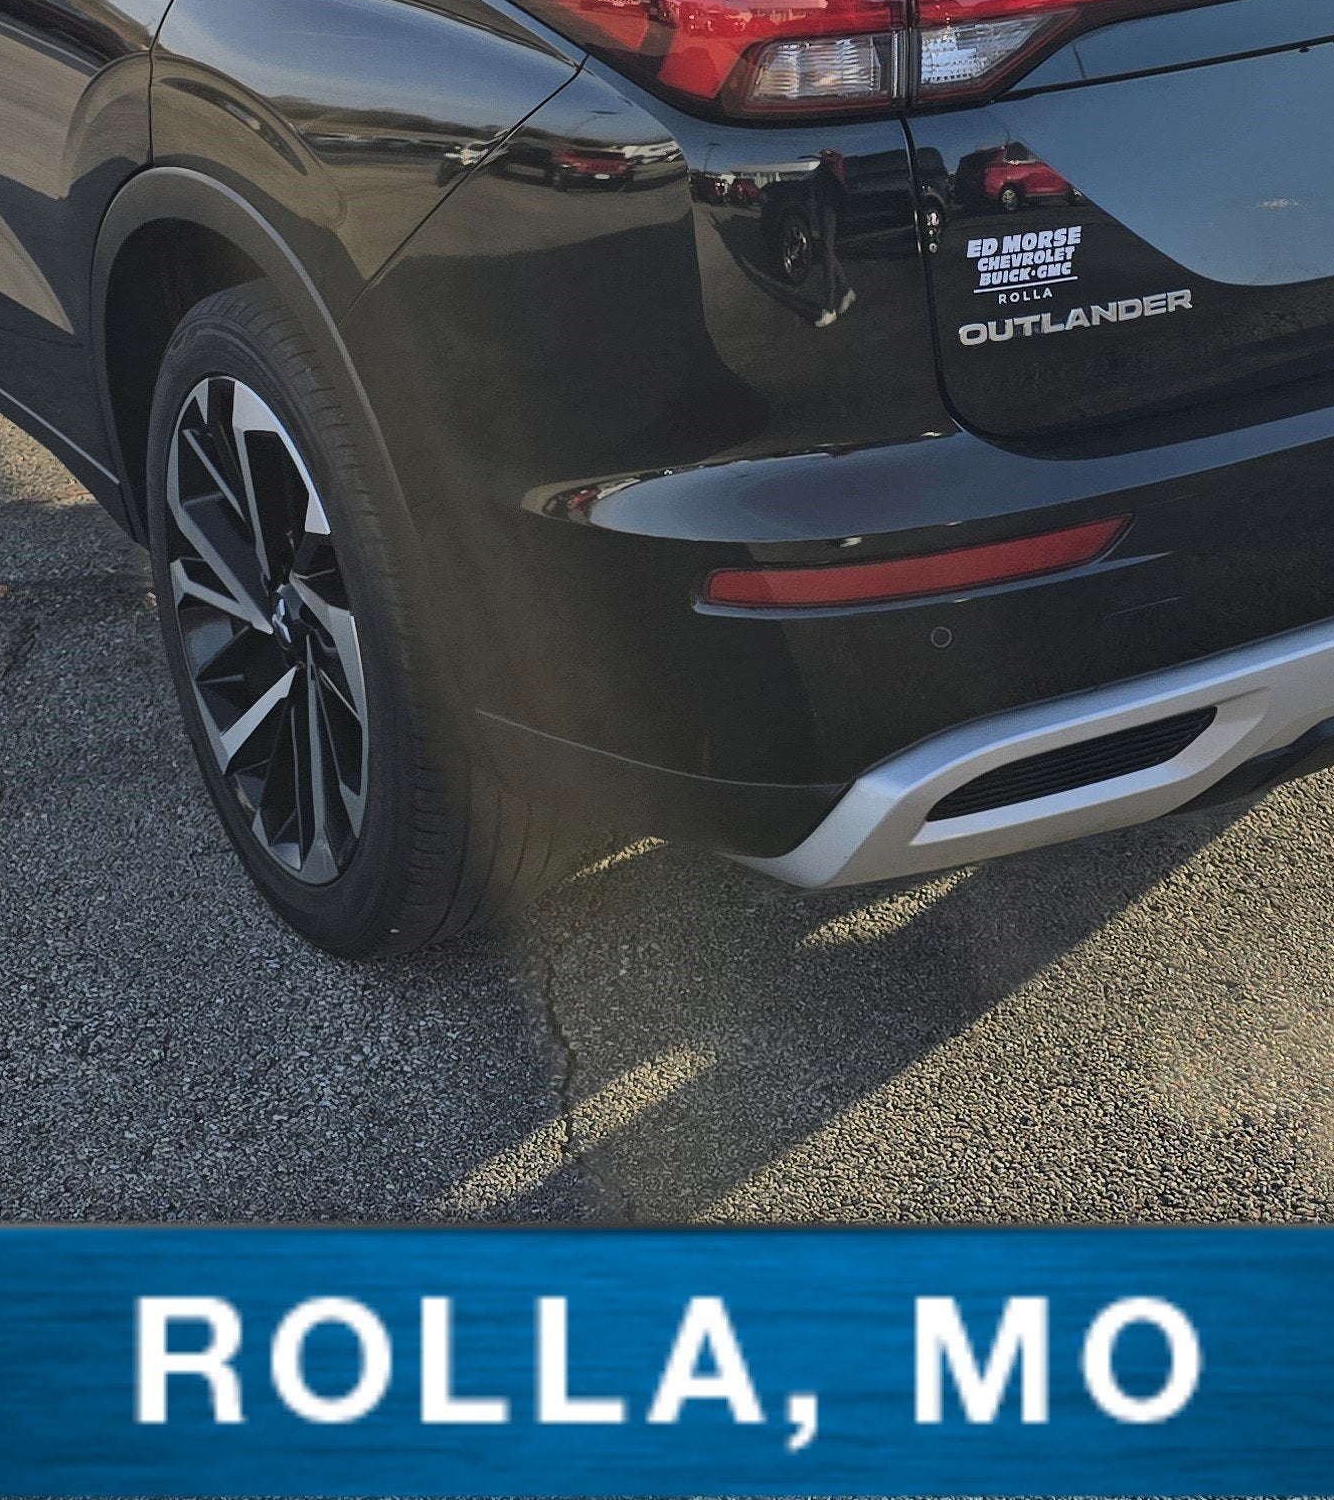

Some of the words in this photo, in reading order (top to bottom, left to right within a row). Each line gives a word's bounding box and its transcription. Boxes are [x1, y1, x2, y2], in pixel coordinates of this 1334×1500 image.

[966, 237, 998, 258] ED
[1002, 226, 1082, 253] MORSE
[977, 246, 1075, 272] CHEVROLET
[998, 287, 1053, 305] ROLLA
[958, 289, 1193, 346] OUTLANDER
